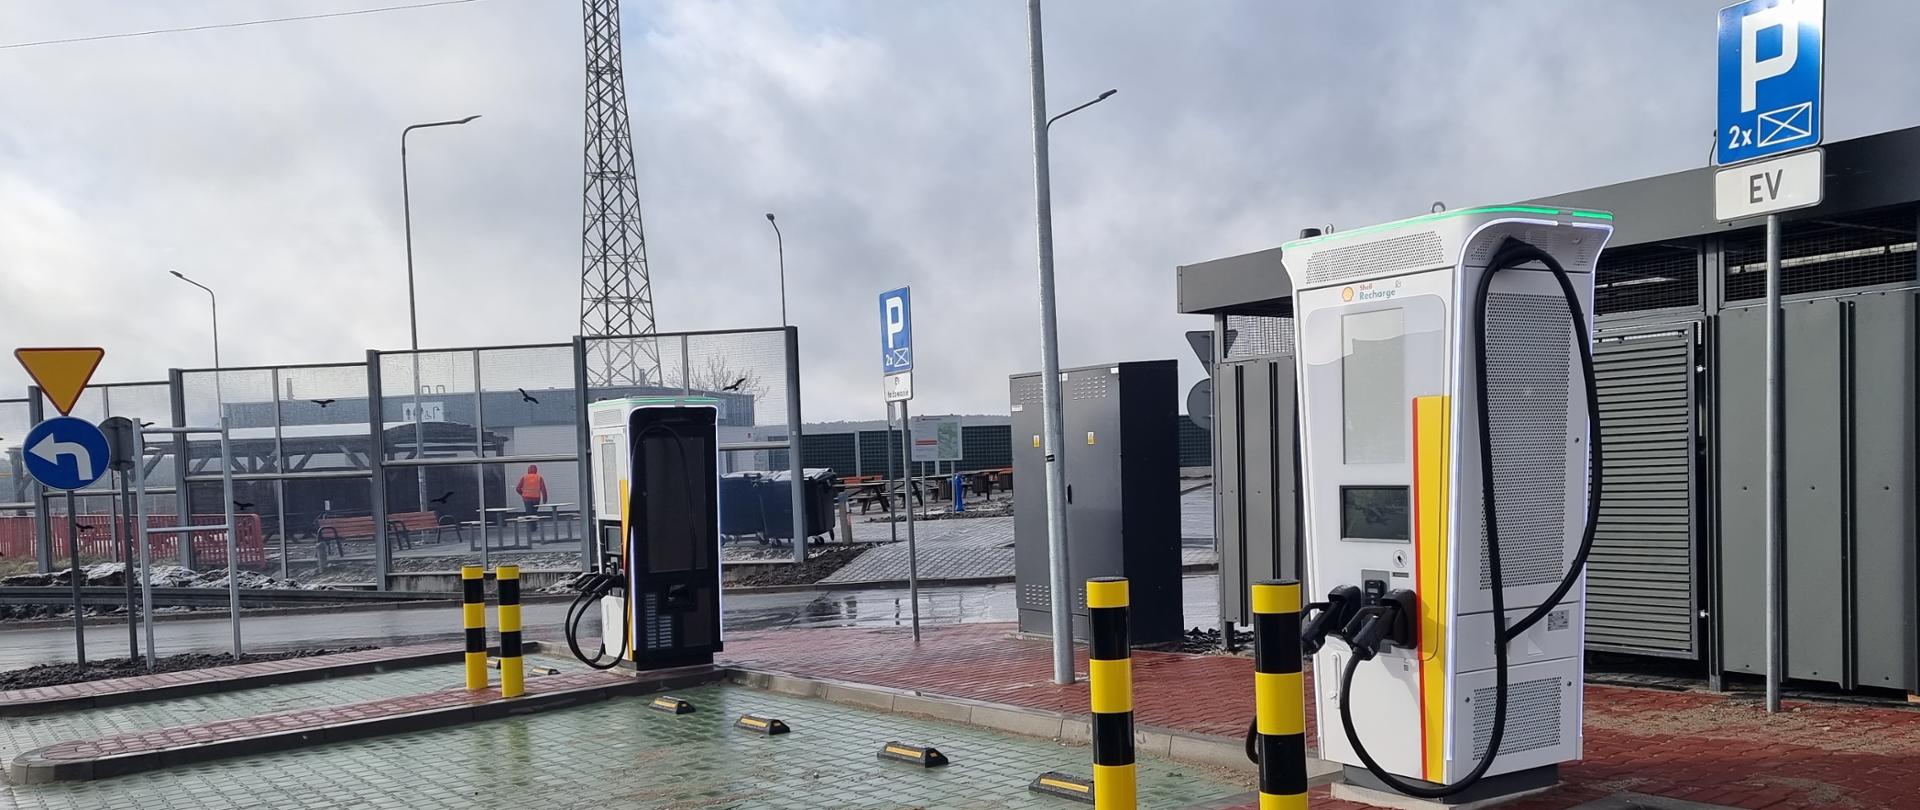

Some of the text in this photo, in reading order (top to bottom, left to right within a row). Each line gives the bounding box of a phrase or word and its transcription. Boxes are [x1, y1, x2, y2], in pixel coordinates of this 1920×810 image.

[1741, 4, 1799, 113] P
[1728, 125, 1752, 149] 2x
[1750, 169, 1783, 204] EV
[1360, 290, 1396, 300] Recharge
[886, 296, 904, 349] P
[885, 354, 894, 367] 2x
